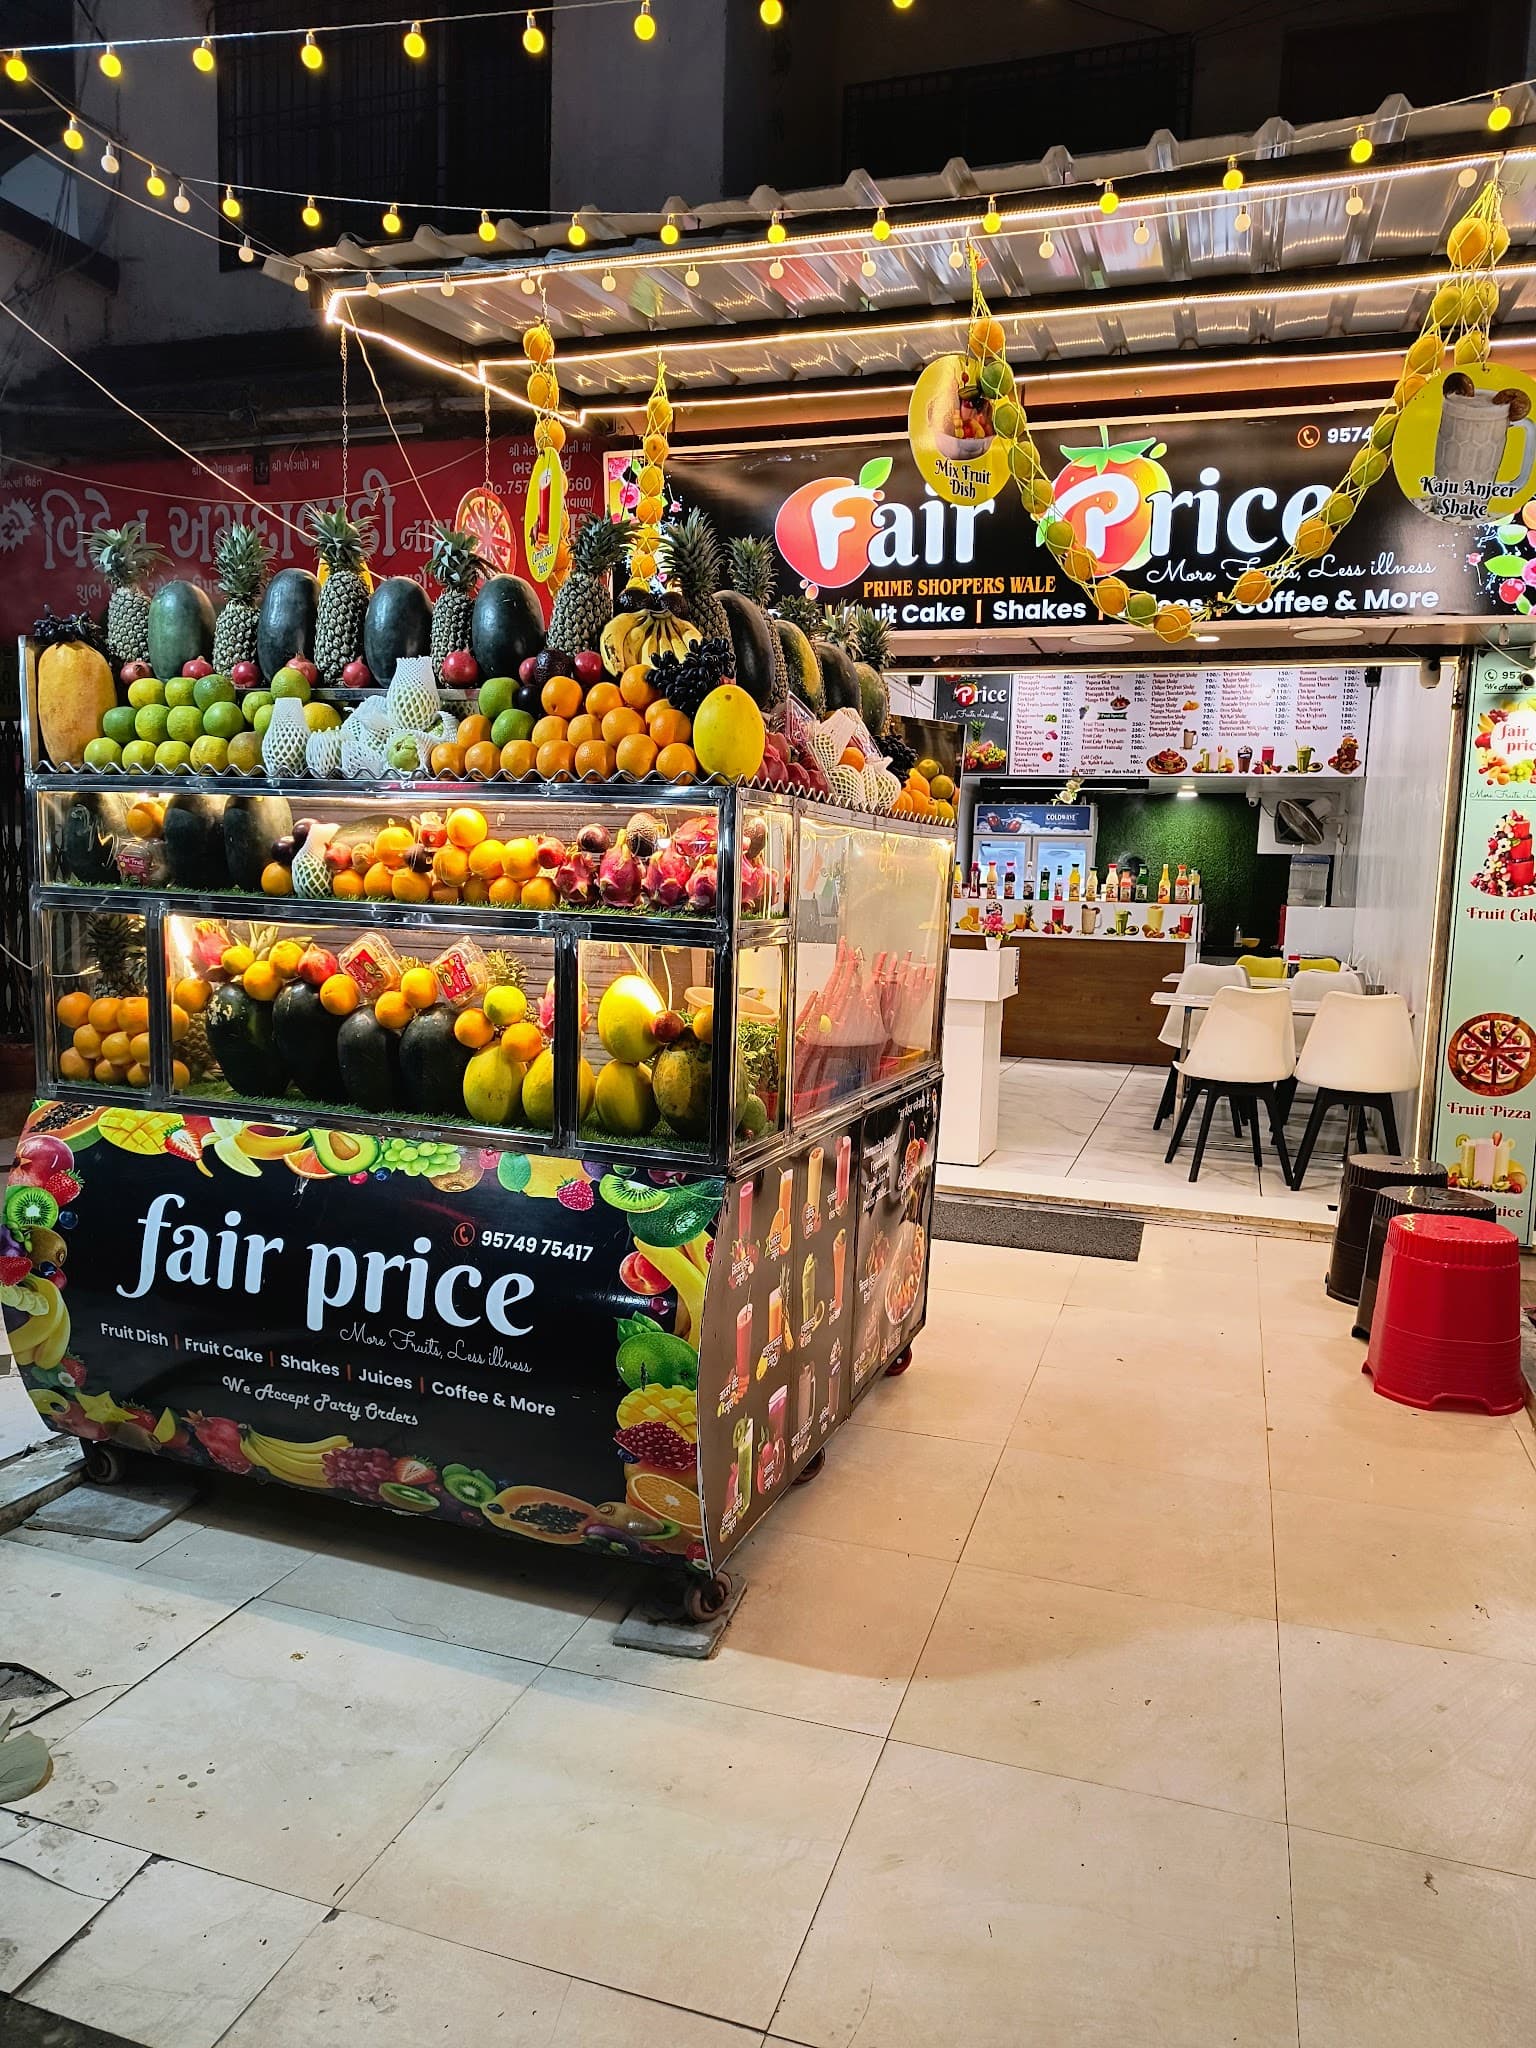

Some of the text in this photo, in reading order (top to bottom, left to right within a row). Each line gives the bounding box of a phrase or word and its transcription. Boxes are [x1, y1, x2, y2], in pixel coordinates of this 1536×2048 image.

[1327, 426, 1374, 444] 9574
[935, 459, 991, 484] Mix Fruit
[950, 479, 976, 499] Dish
[1420, 476, 1517, 499] Kaju Anjeer
[1440, 498, 1488, 518] Shake
[810, 482, 995, 571] Fair
[1146, 559, 1216, 583] More
[1308, 554, 1366, 578] Less
[1370, 551, 1437, 575] illness
[863, 576, 1056, 598] PRIME SHOPPERS WALE
[902, 602, 966, 624] Cake
[992, 599, 1087, 621] Shakes
[1335, 589, 1358, 611] &
[1364, 588, 1439, 610] More
[954, 685, 1007, 703] Price
[1498, 724, 1528, 740] fair
[1466, 906, 1505, 920] Fruit
[1447, 1102, 1531, 1119] Fruit Pizza
[481, 1229, 594, 1262] 95749 75417
[116, 1194, 535, 1337] fair price
[339, 1321, 533, 1373] More Fruits, Less illness
[101, 1322, 556, 1417] Fruit Dish Fruit Cake Shakes Juices Coffee & More
[222, 1375, 419, 1426] We Accept Party Orders
